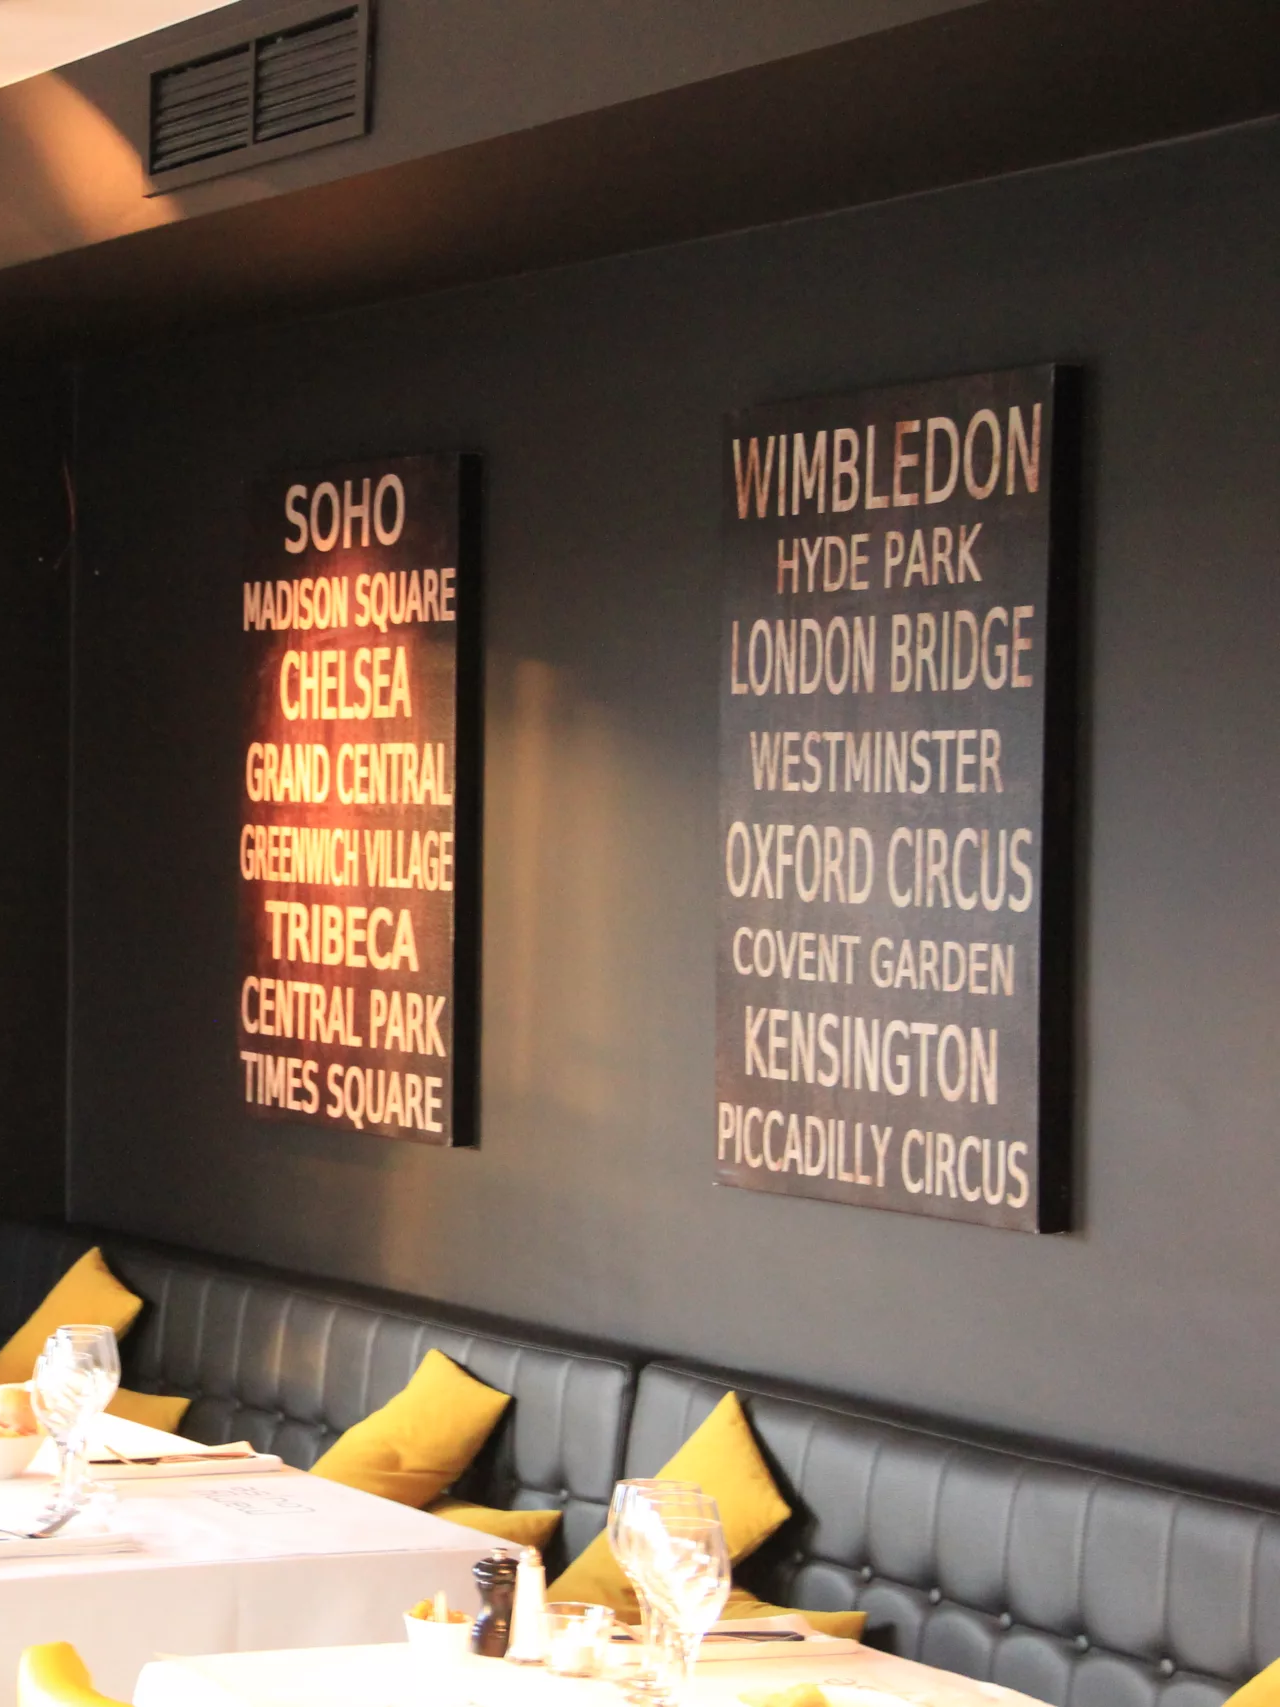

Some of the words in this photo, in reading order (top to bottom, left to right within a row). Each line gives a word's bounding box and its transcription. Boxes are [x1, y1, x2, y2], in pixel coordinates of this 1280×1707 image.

[733, 403, 1042, 519] WIMBLEDON
[284, 474, 405, 554] SOHO
[777, 533, 870, 594] HYDE
[884, 523, 983, 589] PARK
[243, 576, 348, 631] MADISON
[355, 568, 455, 633] SQUARE
[279, 646, 411, 720] CHELSEA
[731, 615, 876, 696] LONDON
[890, 605, 1035, 693] BRIDGE
[246, 742, 330, 804] GRAND
[336, 742, 452, 806] CENTRAL
[750, 729, 1004, 795] WESTMINSTER
[240, 824, 358, 888] GREENWICH
[364, 828, 453, 892] VILLAGE
[726, 820, 874, 905] OXFORD
[887, 826, 1033, 912] CIRCUS
[265, 899, 418, 972] TRIBECA
[732, 926, 861, 984] COVENT
[870, 937, 1015, 996] GARDEN
[241, 975, 362, 1048] CENTRAL
[370, 988, 446, 1058] PARK
[744, 1005, 998, 1105] KENSINGTON
[240, 1050, 319, 1115] TIMES
[326, 1062, 443, 1133] SQUARE
[717, 1102, 892, 1187] PICCADILLY
[901, 1128, 1030, 1208] CIRCUS
